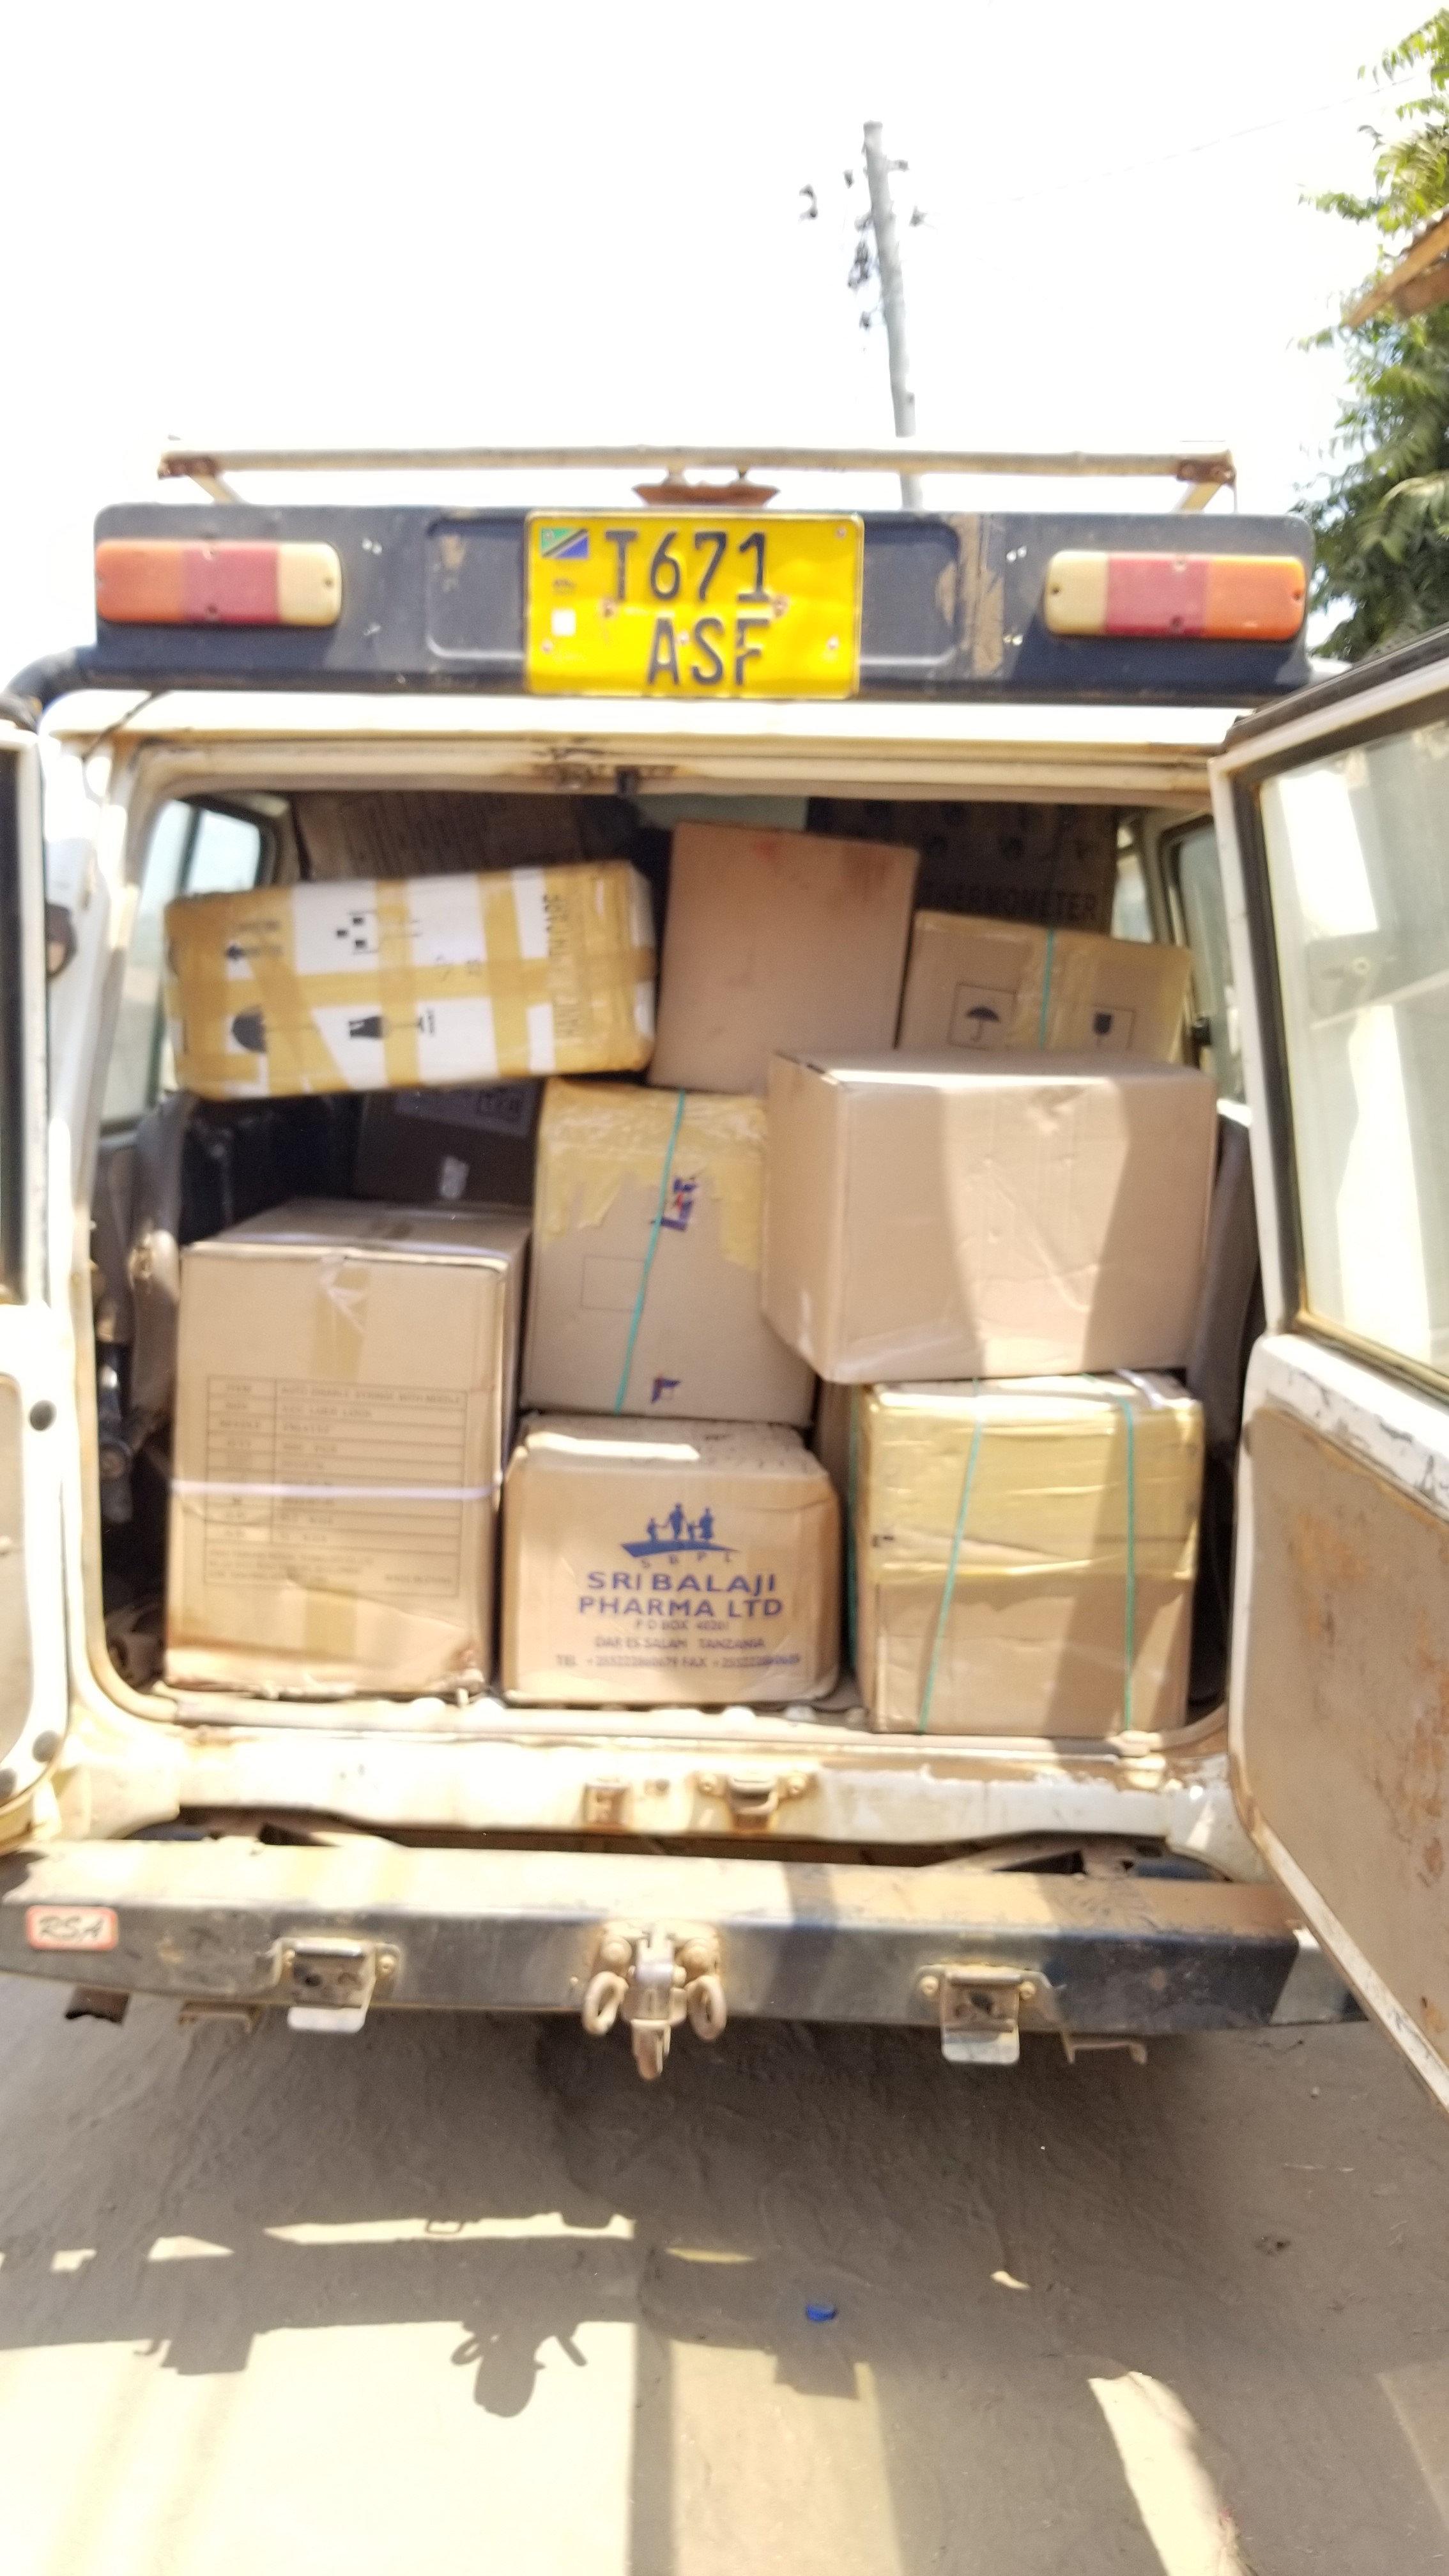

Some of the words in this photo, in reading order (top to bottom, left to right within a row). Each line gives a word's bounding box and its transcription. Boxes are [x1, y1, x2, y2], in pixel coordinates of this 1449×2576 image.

[647, 617, 771, 687] ASF
[923, 880, 1098, 923] THERMOMETER
[586, 1570, 642, 1591] SRI
[651, 1573, 776, 1597] BALAJI
[578, 1596, 715, 1618] PHARMA
[728, 1598, 784, 1618] LTD
[662, 1620, 689, 1631] BOX
[595, 1637, 622, 1649] DAR
[627, 1637, 640, 1649] ES
[642, 1637, 688, 1650] SALAM
[697, 1638, 766, 1651] TANZANIA
[555, 1653, 578, 1667] TEL
[683, 1655, 707, 1668] FAX
[39, 1915, 105, 1942] RSA
